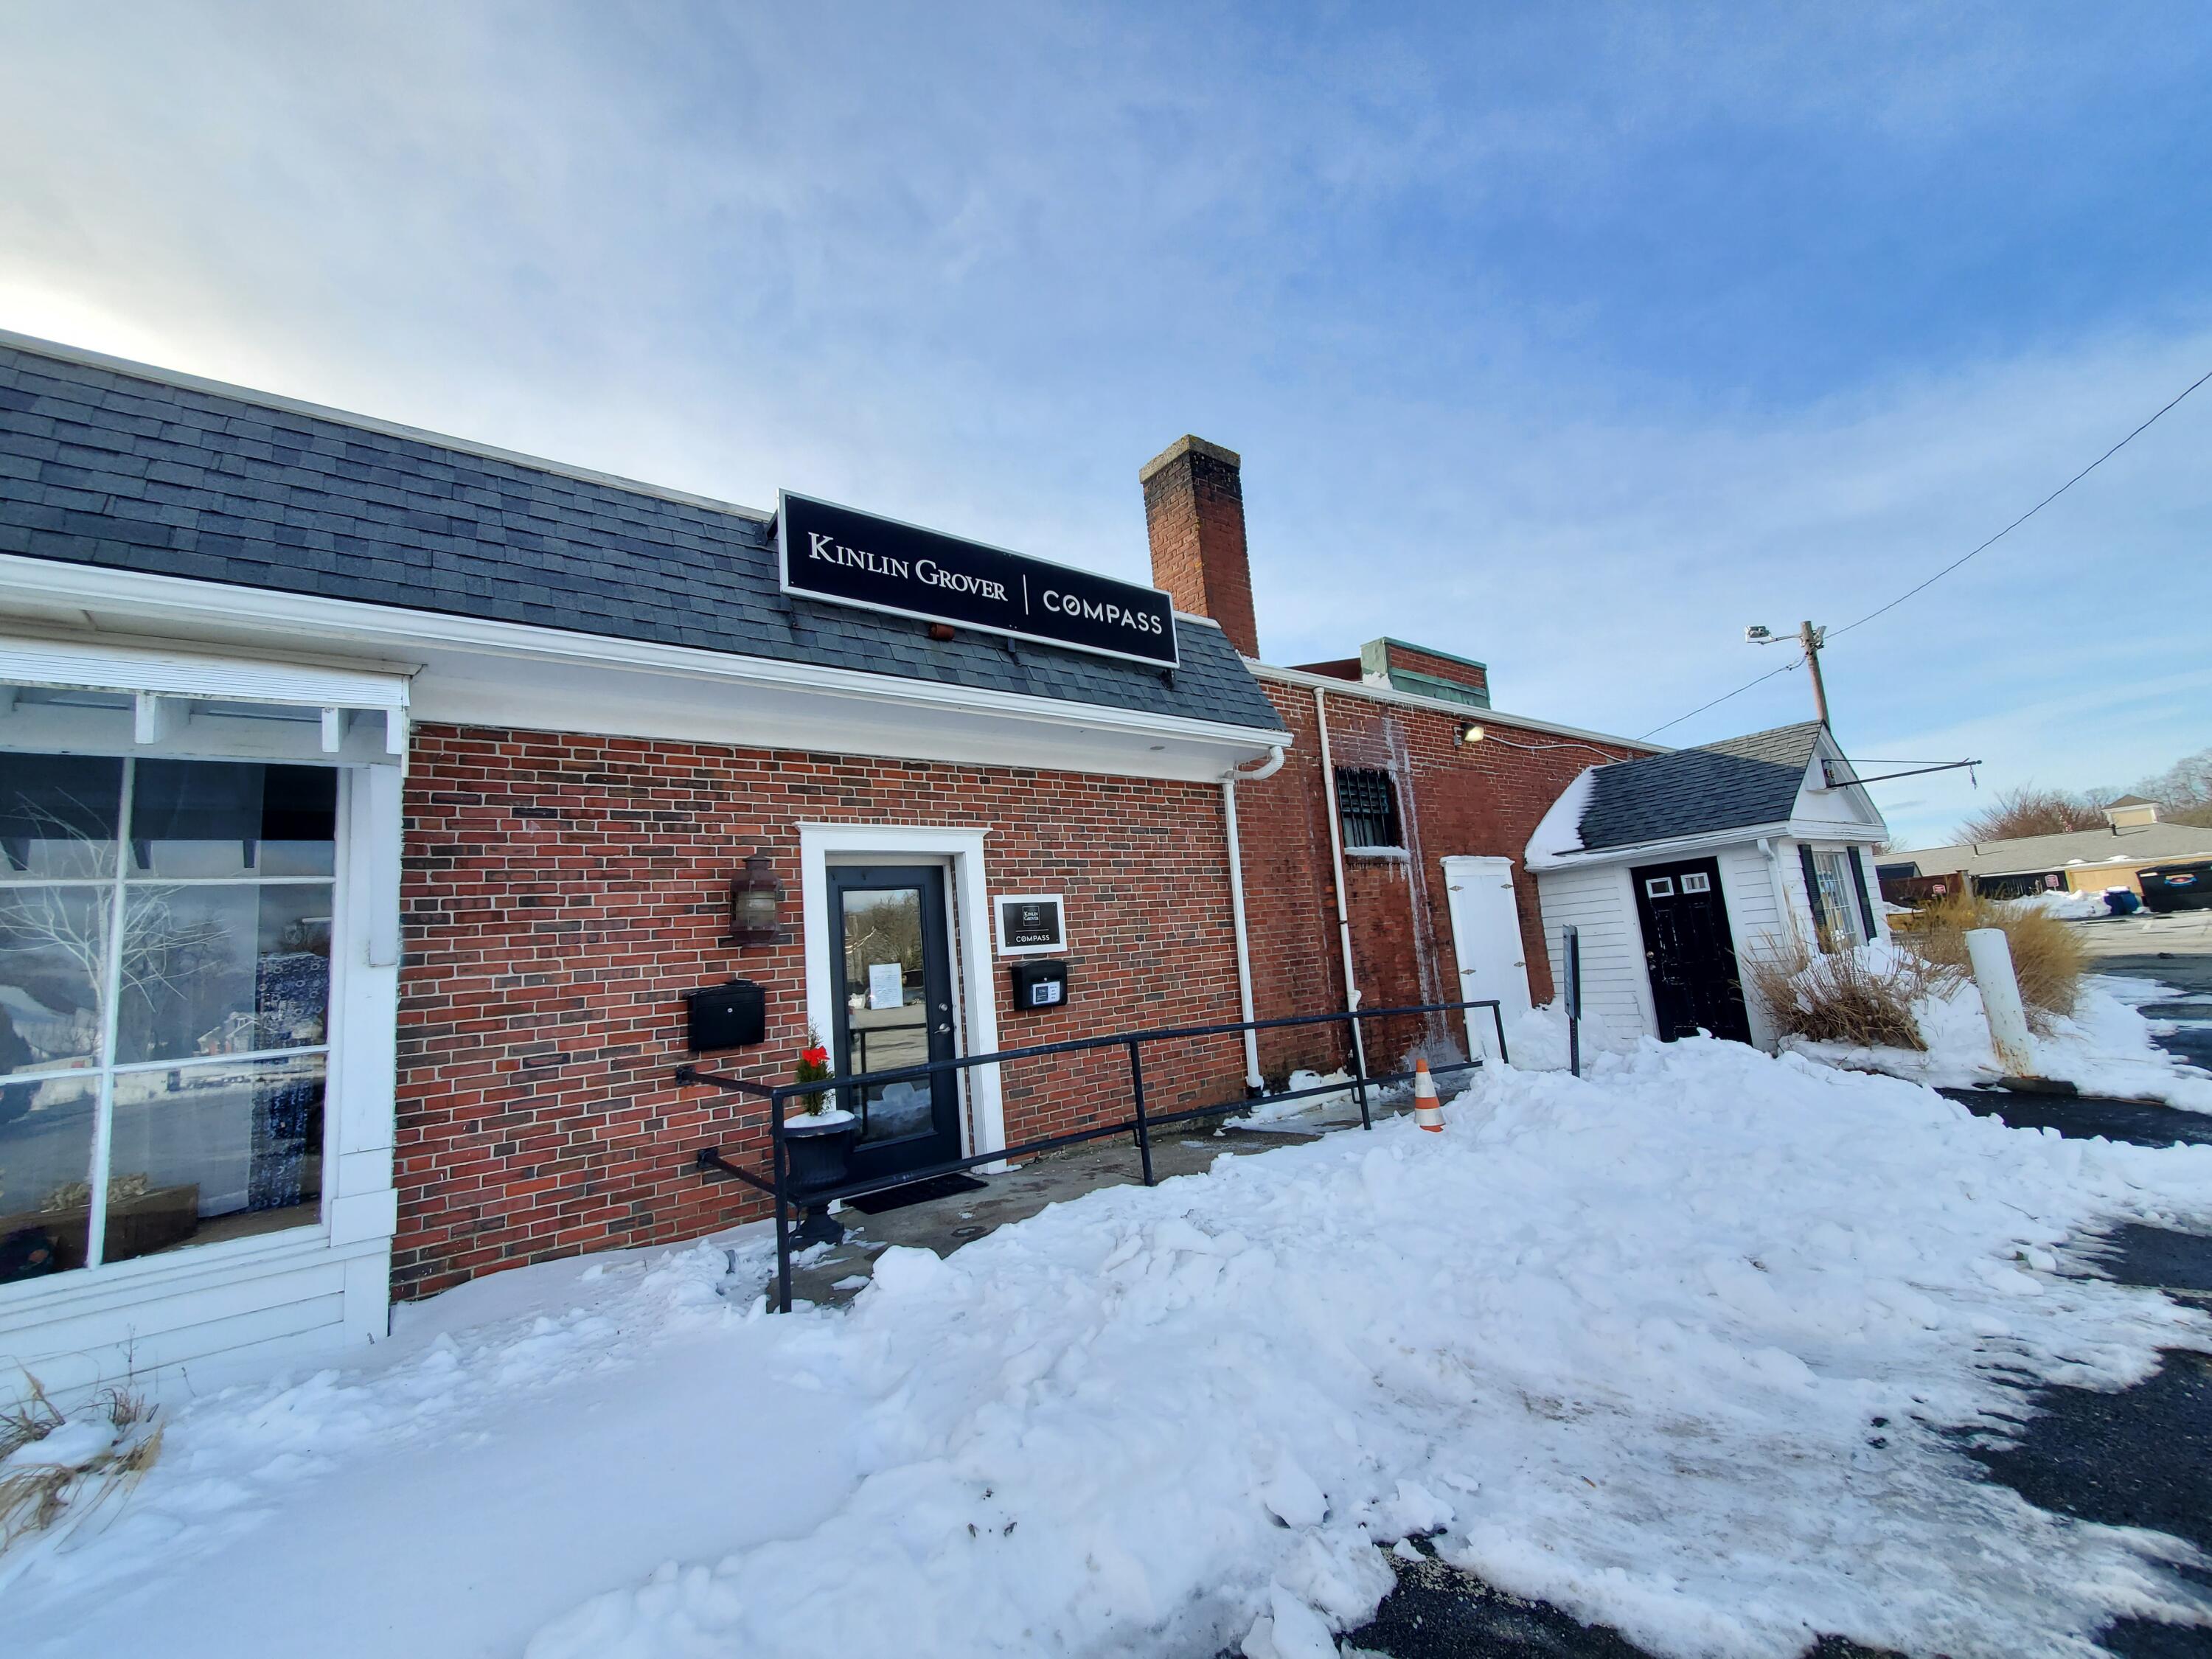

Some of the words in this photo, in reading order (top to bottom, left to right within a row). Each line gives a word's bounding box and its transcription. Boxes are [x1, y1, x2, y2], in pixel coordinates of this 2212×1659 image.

[807, 531, 910, 580] KINLIN
[915, 559, 1009, 602] GROVER
[1043, 589, 1163, 635] COMPASS
[1015, 934, 1050, 943] COMPASS
